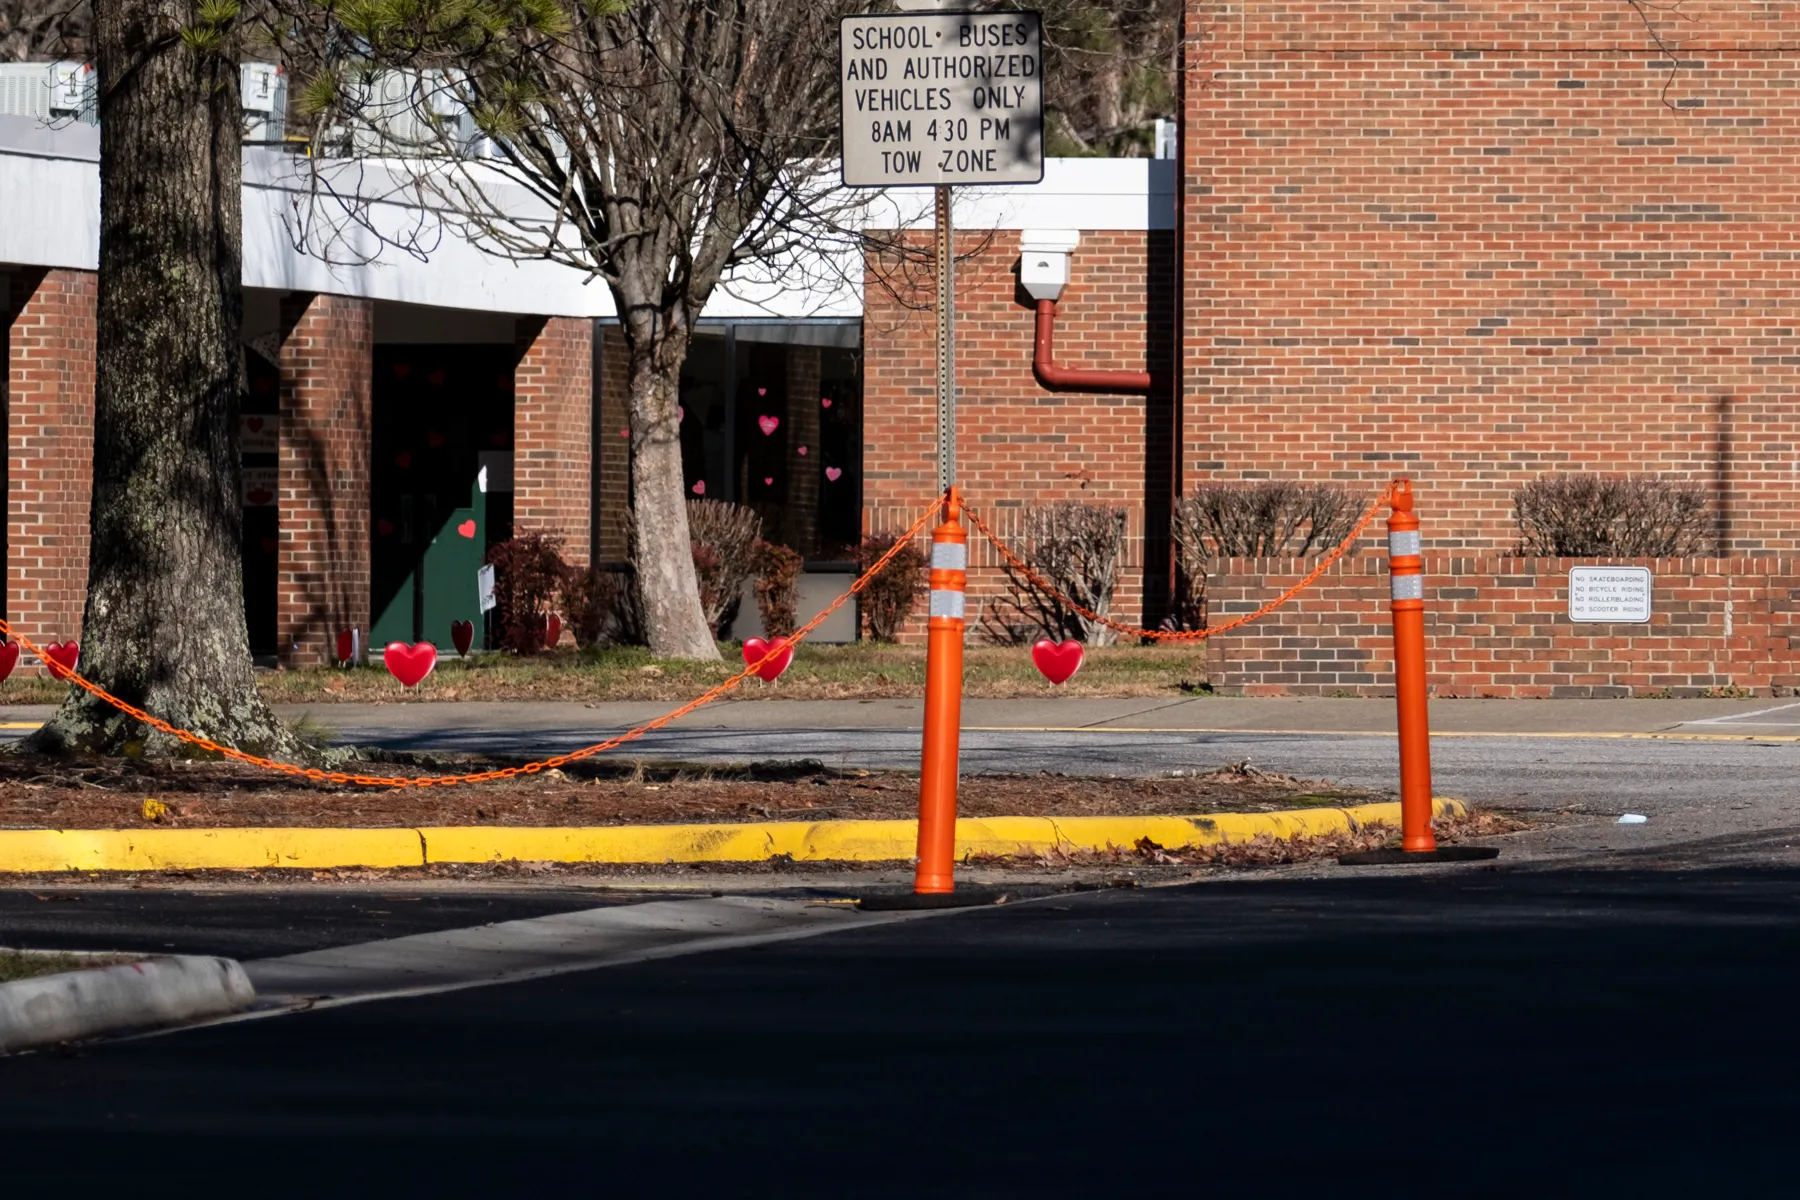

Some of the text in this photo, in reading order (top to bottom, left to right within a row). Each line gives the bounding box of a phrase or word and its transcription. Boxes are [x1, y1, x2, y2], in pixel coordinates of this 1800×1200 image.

[852, 22, 1028, 50] SCHOOL BUSES
[847, 54, 1035, 81] AND AUTHORIZED
[855, 85, 1026, 112] VEHICLES ONLY
[871, 119, 912, 143] 8AM
[980, 116, 1010, 141] PM
[881, 148, 998, 174] TOW ZONE
